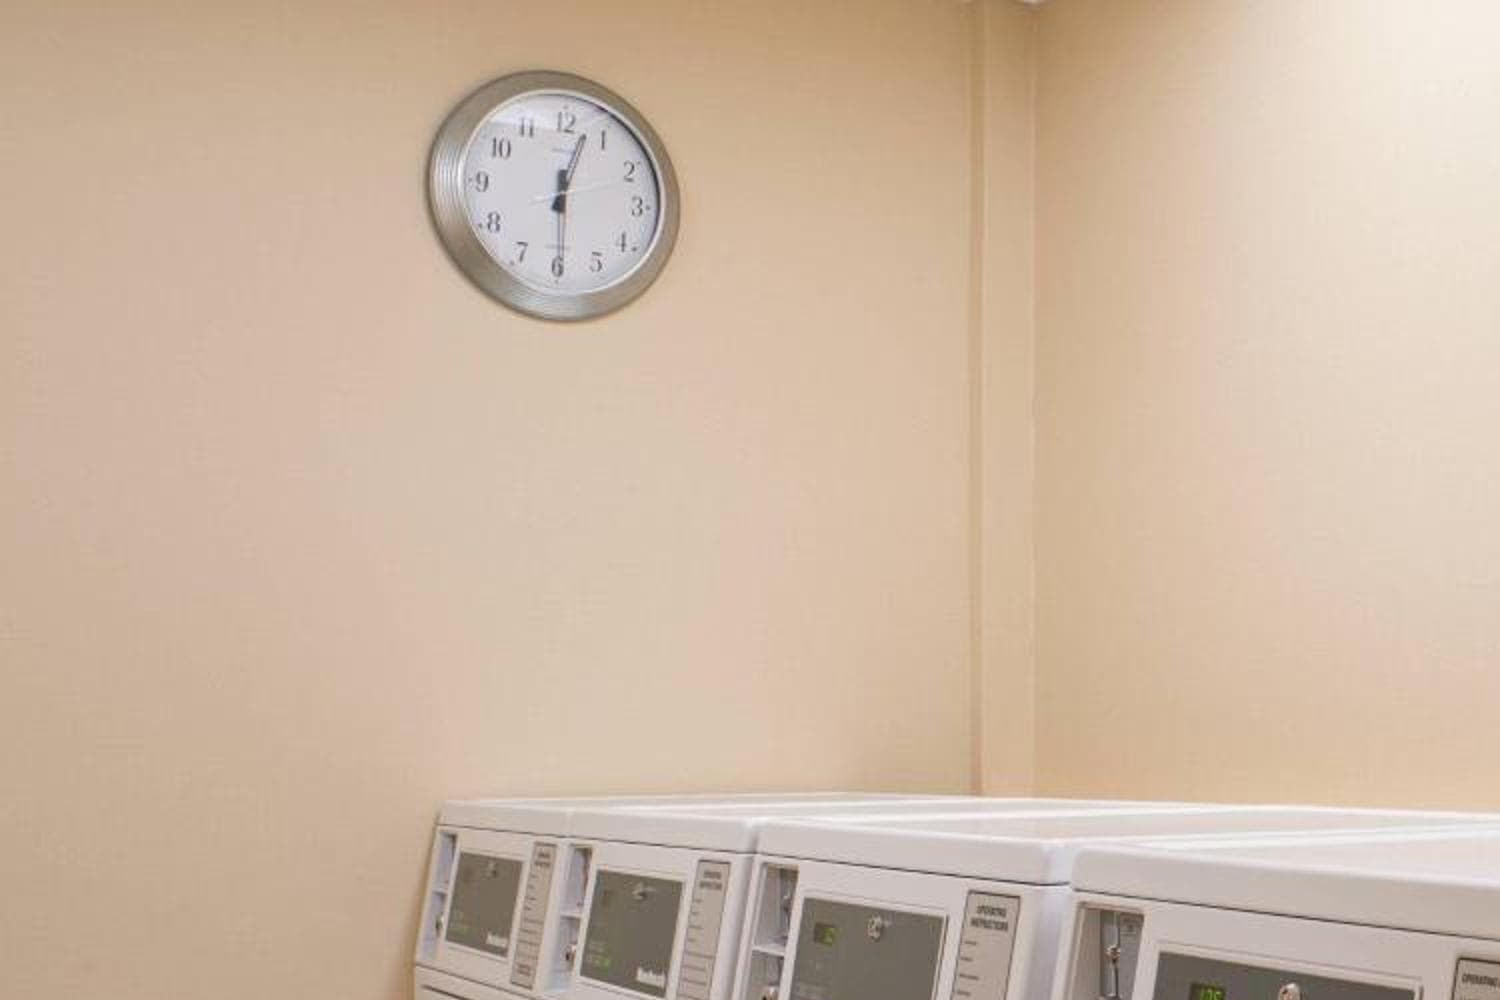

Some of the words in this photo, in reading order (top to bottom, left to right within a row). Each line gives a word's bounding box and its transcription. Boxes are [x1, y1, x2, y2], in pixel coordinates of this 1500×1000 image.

[518, 116, 535, 139] 11
[556, 111, 577, 134] 12
[491, 137, 512, 160] 10
[599, 129, 607, 151] 1
[474, 172, 490, 193] 9
[623, 161, 636, 183] 2
[630, 196, 644, 217] 3
[486, 211, 502, 233] 8
[514, 241, 529, 263] 7
[615, 231, 627, 253] 4
[551, 256, 564, 278] 6
[589, 251, 603, 273] 5
